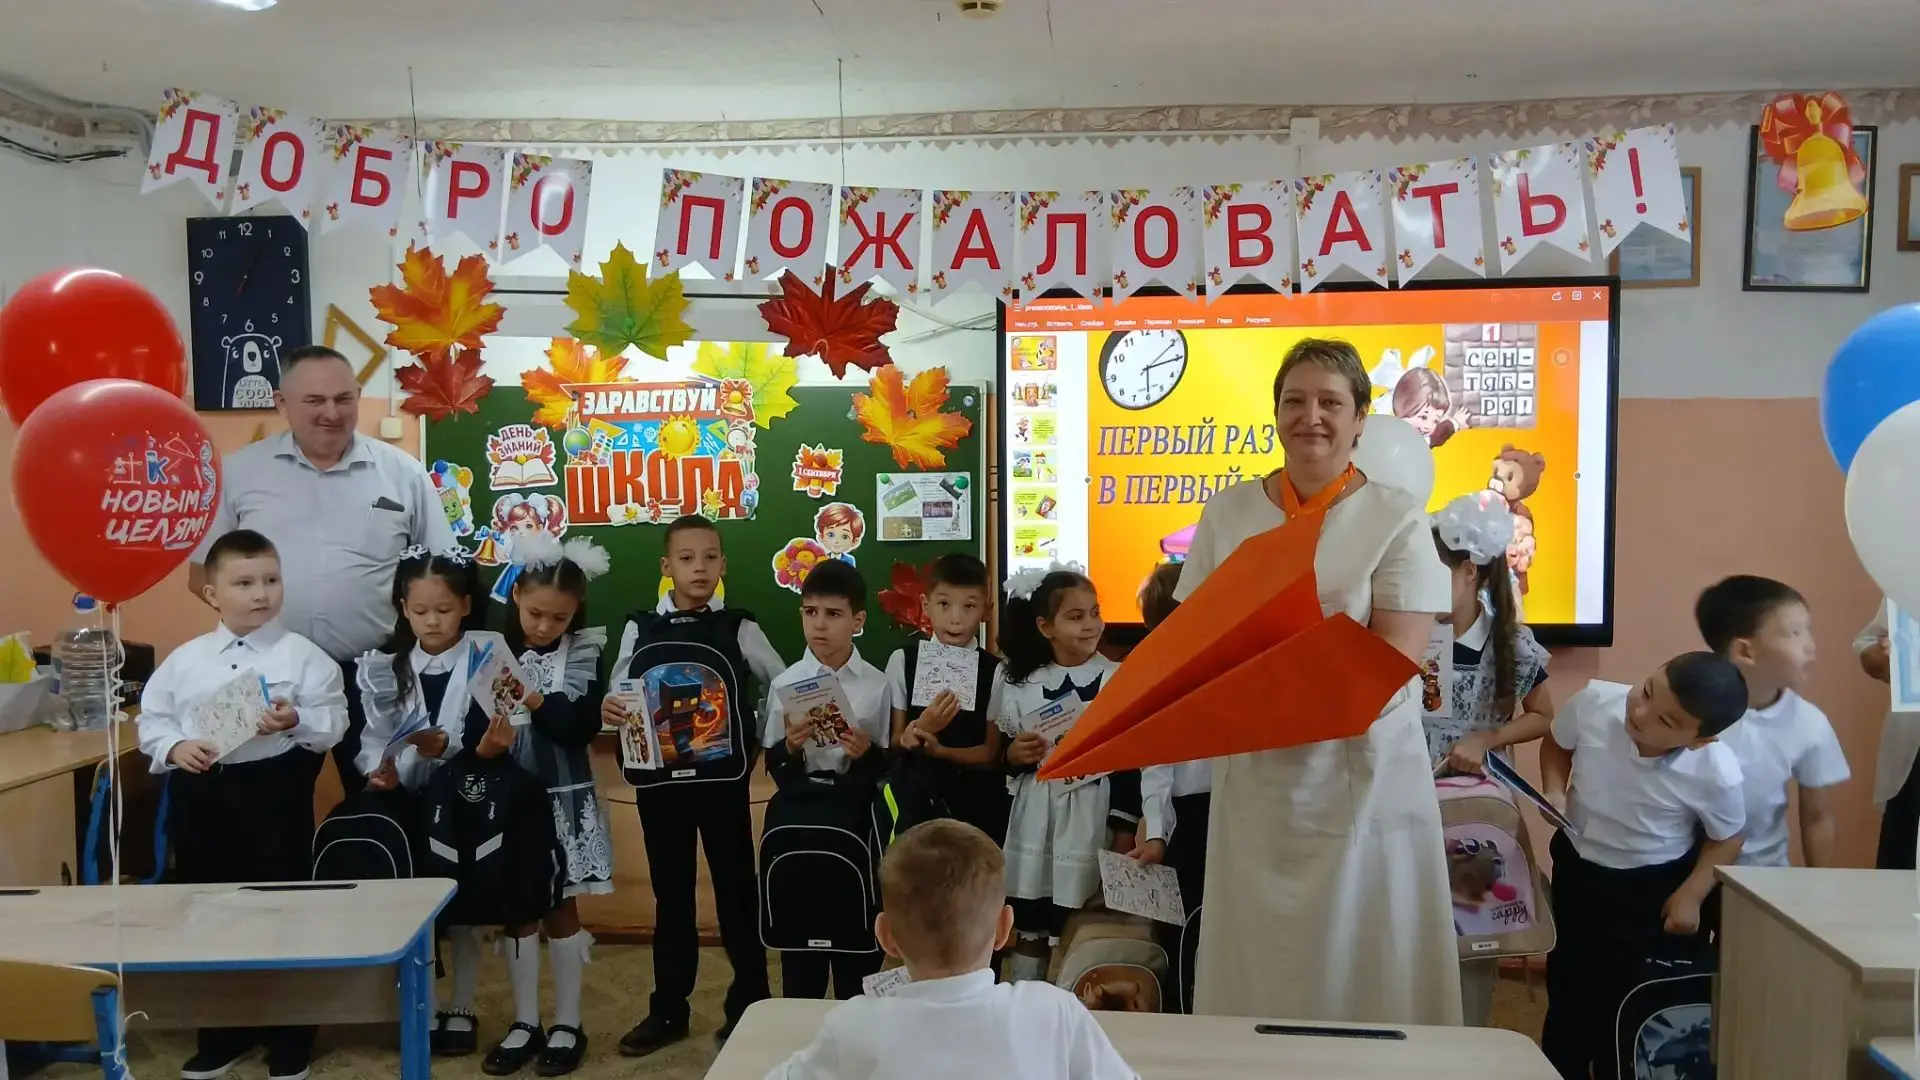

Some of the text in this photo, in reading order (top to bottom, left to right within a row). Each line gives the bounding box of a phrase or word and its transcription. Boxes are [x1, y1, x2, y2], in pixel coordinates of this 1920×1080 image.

[164, 109, 1649, 276] ДОБРО ПОЖАЛОВАТЬ!
[219, 230, 226, 239] 11
[238, 222, 252, 236] 12
[268, 229, 272, 238] 1
[201, 248, 213, 258] 10
[284, 247, 291, 256] 2
[194, 271, 203, 285] 9
[291, 269, 300, 283] 3
[203, 297, 209, 306] 8
[287, 296, 293, 305] 4
[222, 314, 227, 324] 7
[272, 314, 278, 323] 5
[245, 319, 254, 332] 6
[1487, 326, 1496, 343] 1
[1124, 338, 1134, 347] 11
[1114, 353, 1125, 364] 10
[1111, 374, 1117, 382] 9
[500, 426, 532, 441] ДЕНЬ
[1097, 416, 1217, 456] ПЕРВЫЙ
[1222, 424, 1275, 455] РАЗ
[566, 450, 746, 524] ШКОЛА
[1097, 475, 1116, 504] В
[101, 488, 200, 513] НОВЫМ
[105, 513, 209, 545] ЦЕЛЯМ!
